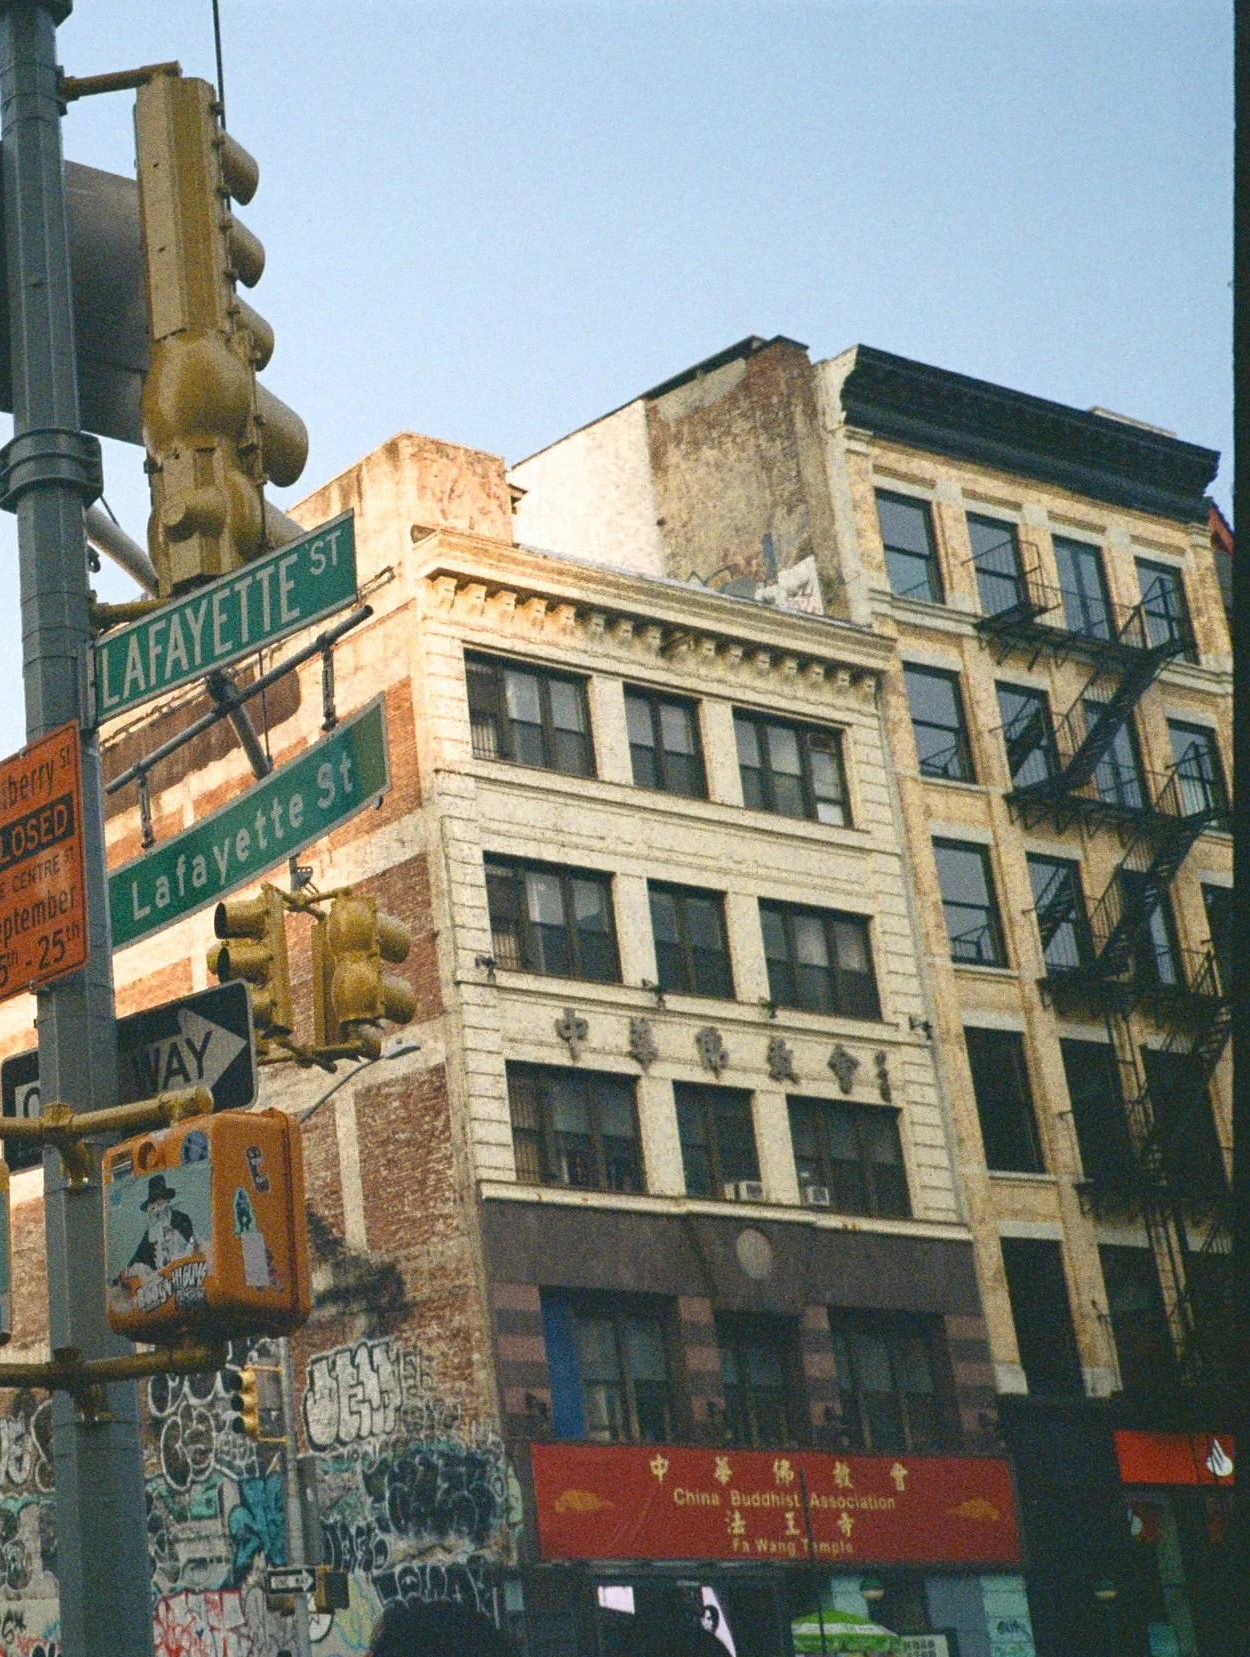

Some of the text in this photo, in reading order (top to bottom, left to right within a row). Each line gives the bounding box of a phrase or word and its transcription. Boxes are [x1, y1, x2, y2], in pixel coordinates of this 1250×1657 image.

[101, 530, 342, 708] LAFAYETTE ST
[131, 751, 353, 922] Lafayette St
[12, 856, 60, 894] CENTRE
[37, 922, 80, 971] 25th
[673, 1488, 895, 1510] China Buddhist Association
[732, 1538, 854, 1559] Fa Wang Tmple
